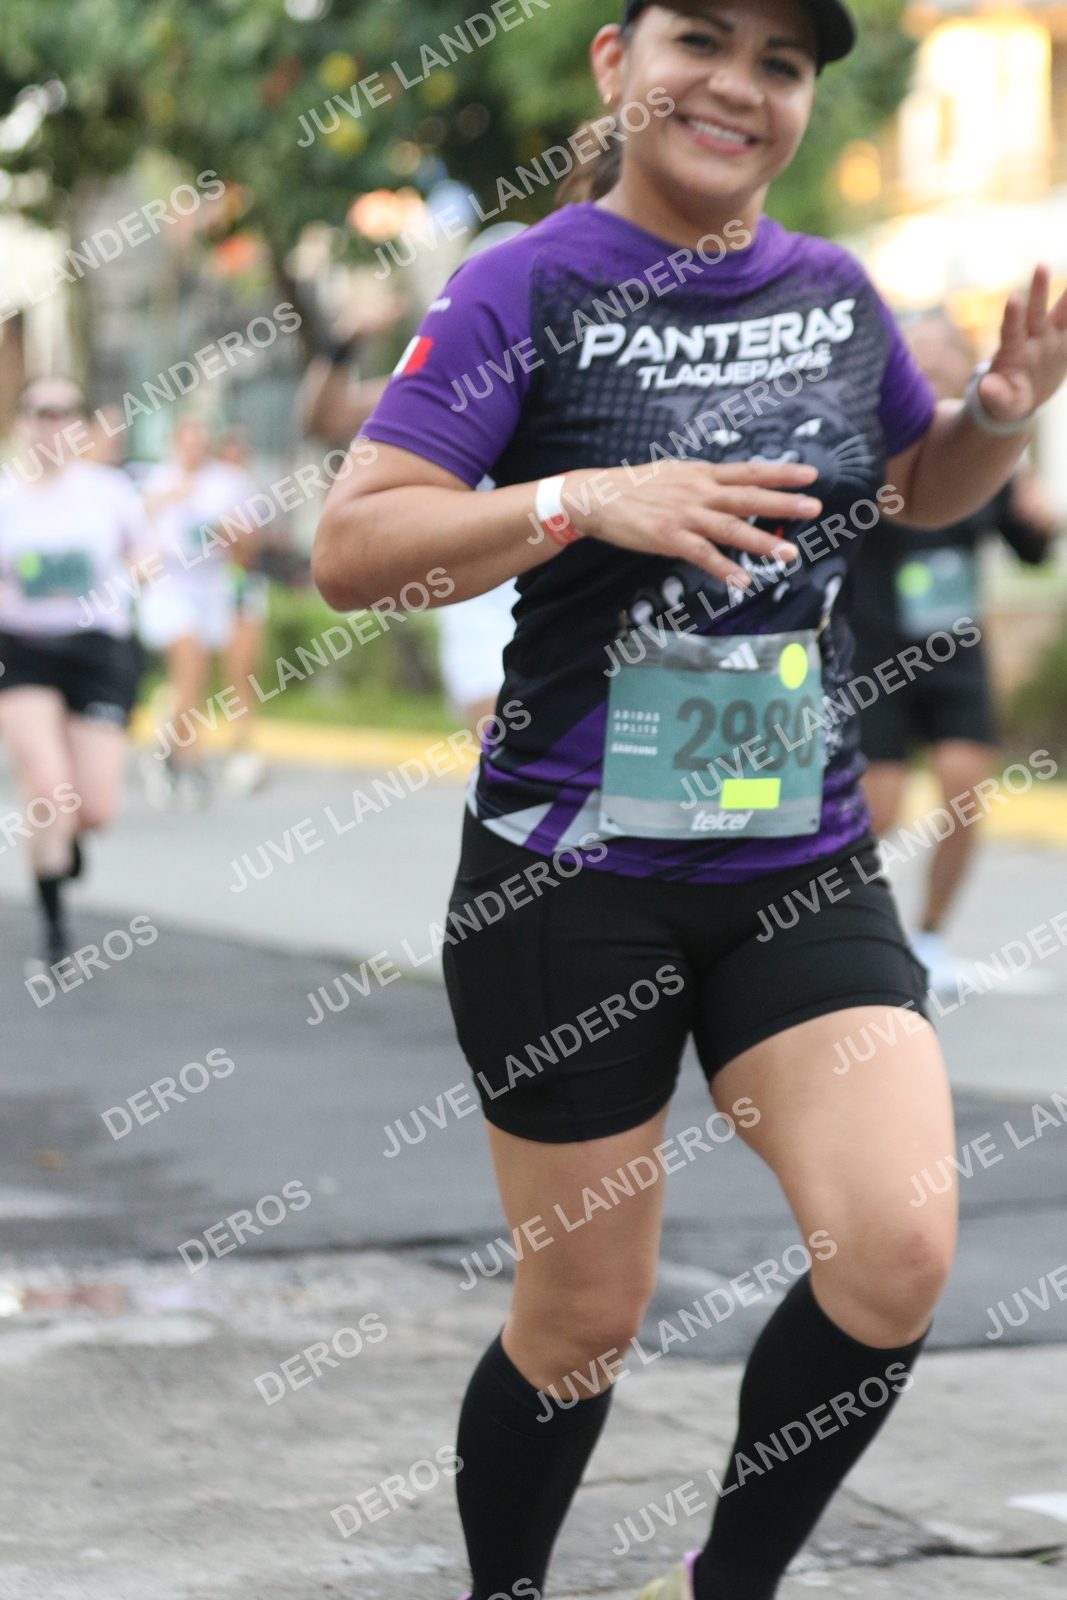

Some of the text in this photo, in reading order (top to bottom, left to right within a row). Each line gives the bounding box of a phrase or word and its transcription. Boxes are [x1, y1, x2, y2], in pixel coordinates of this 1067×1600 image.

[577, 298, 856, 370] PANTERAS
[673, 696, 816, 771] 2980
[691, 810, 754, 831] telcel
